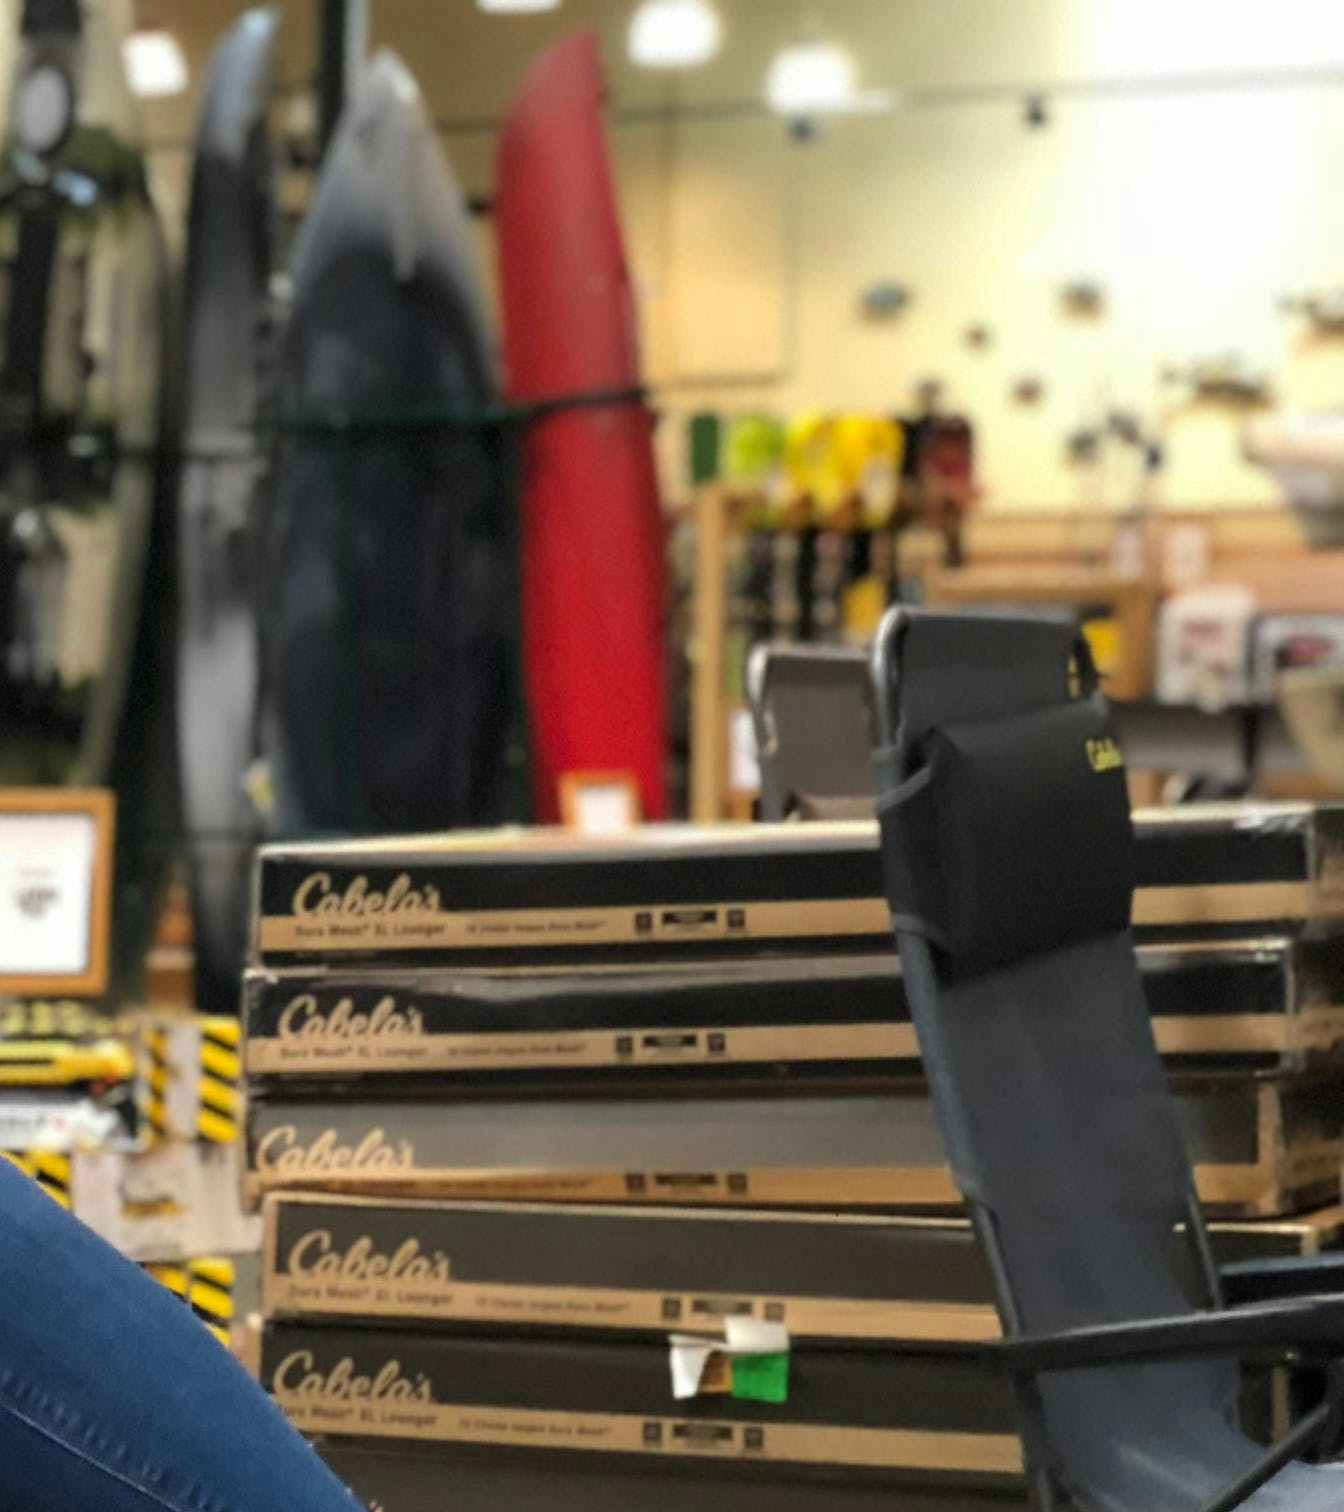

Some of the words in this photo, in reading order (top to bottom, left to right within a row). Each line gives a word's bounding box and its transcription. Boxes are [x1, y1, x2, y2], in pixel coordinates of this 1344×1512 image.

[293, 872, 441, 917] Cabela's
[279, 995, 422, 1039] Cabela's
[256, 1126, 415, 1171] Cabela's
[289, 1230, 449, 1282] Cabela's
[274, 1350, 433, 1402] Cabela's
[284, 1406, 305, 1418] ura
